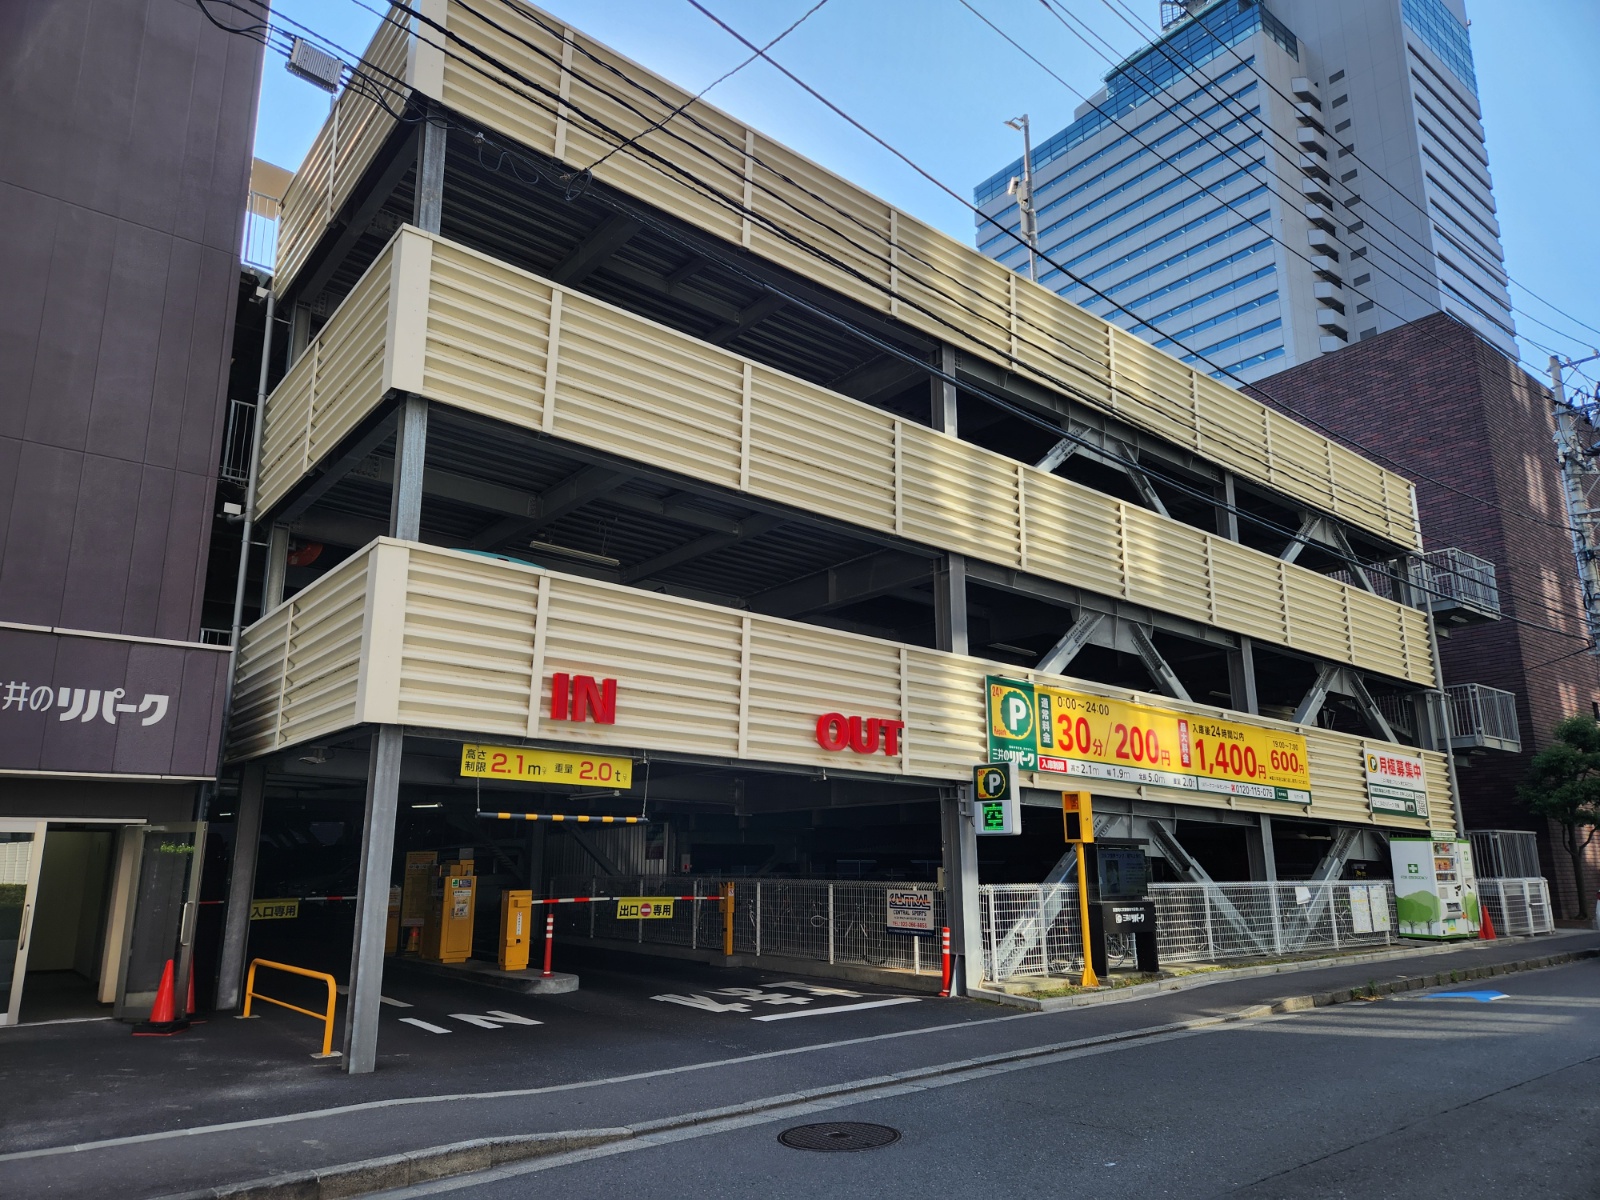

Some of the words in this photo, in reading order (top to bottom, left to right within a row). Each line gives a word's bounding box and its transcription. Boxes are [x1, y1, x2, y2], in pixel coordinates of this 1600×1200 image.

[0, 681, 169, 727] 井のリパーク
[551, 672, 617, 725] IN
[1009, 697, 1027, 731] P
[1041, 697, 1051, 744] 通常料金
[816, 712, 905, 756] OUT
[464, 760, 487, 773] 制限
[465, 748, 487, 761] 高さ
[1195, 738, 1267, 780] 1,400円
[1270, 749, 1305, 775] 600円
[554, 763, 573, 775] 重量
[1379, 757, 1422, 780] 月極募集中
[988, 773, 1001, 793] P
[983, 802, 1004, 831] 空
[251, 905, 296, 918] 入口専用
[619, 905, 639, 917] 出口
[653, 904, 671, 916] 専用
[398, 1010, 545, 1034] IN
